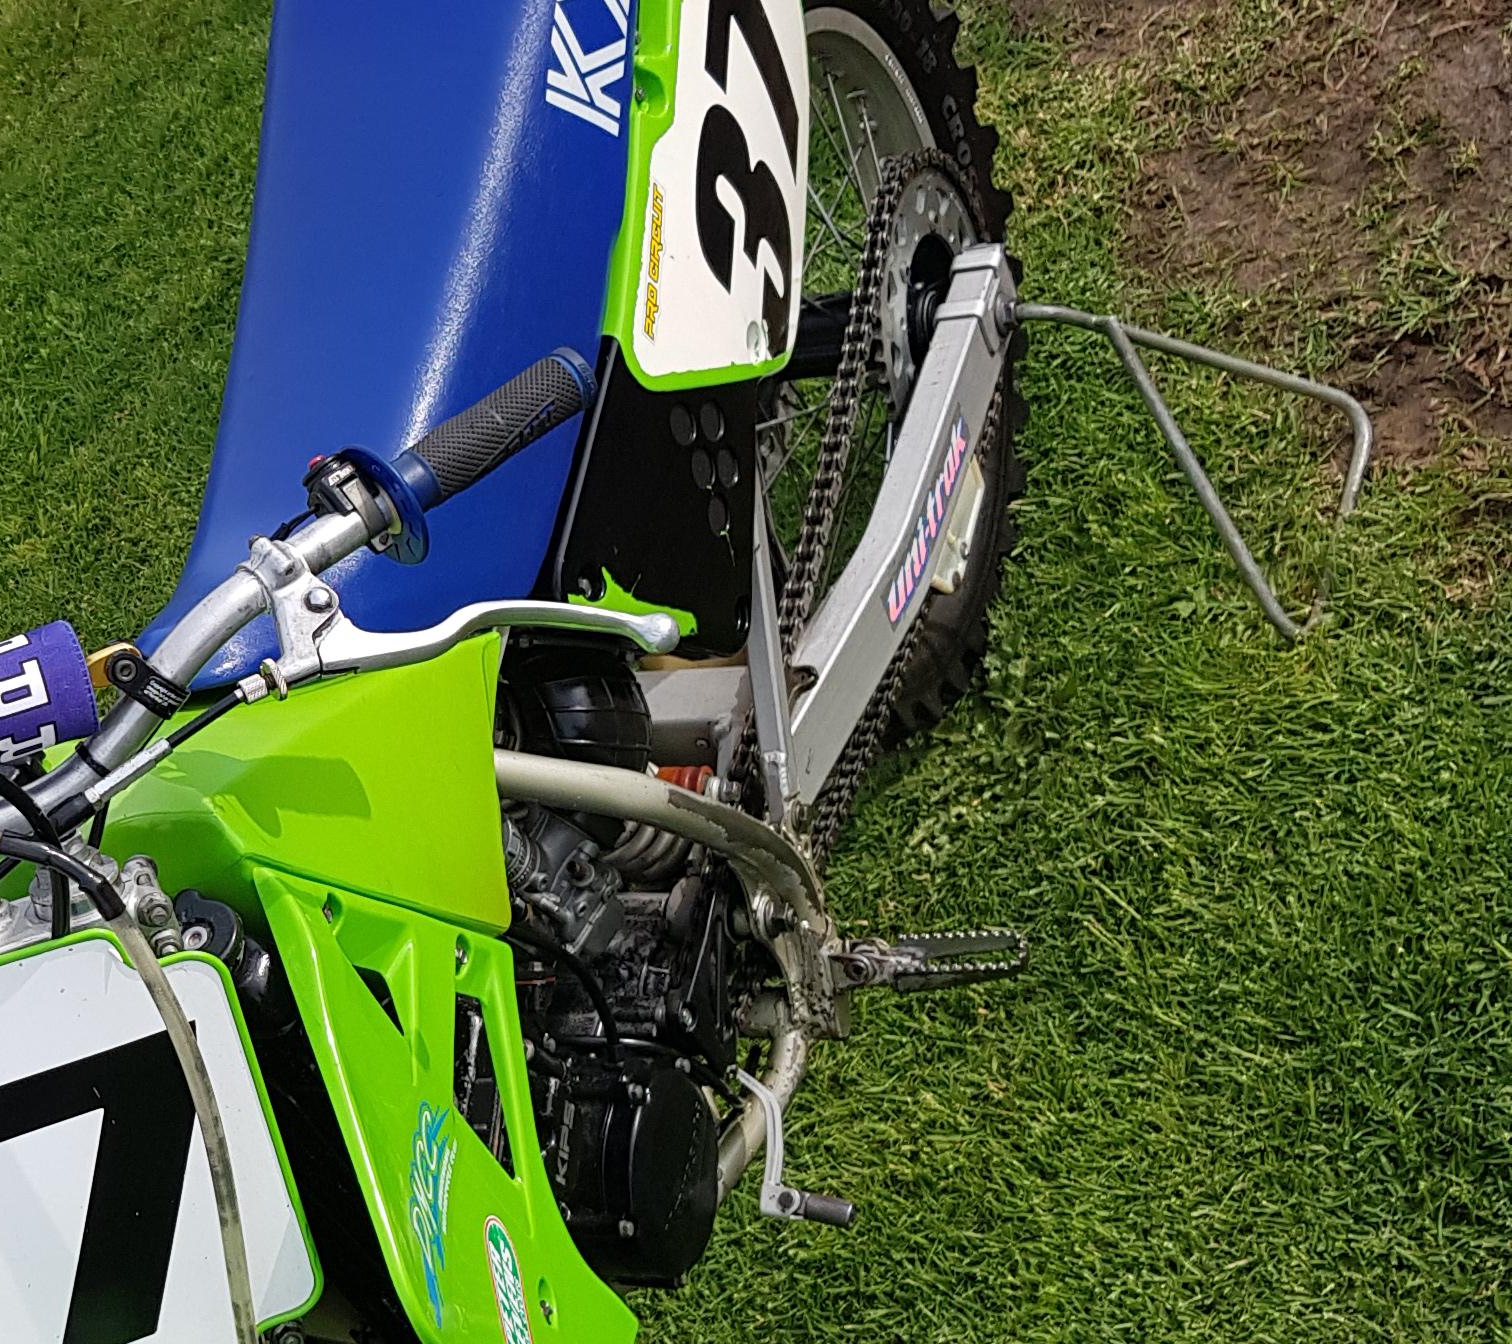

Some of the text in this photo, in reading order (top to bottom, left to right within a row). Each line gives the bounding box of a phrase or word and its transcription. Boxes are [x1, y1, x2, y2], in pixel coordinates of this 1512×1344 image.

[644, 183, 664, 338] PRO CIRCUIT
[555, 1100, 575, 1186] KIPS
